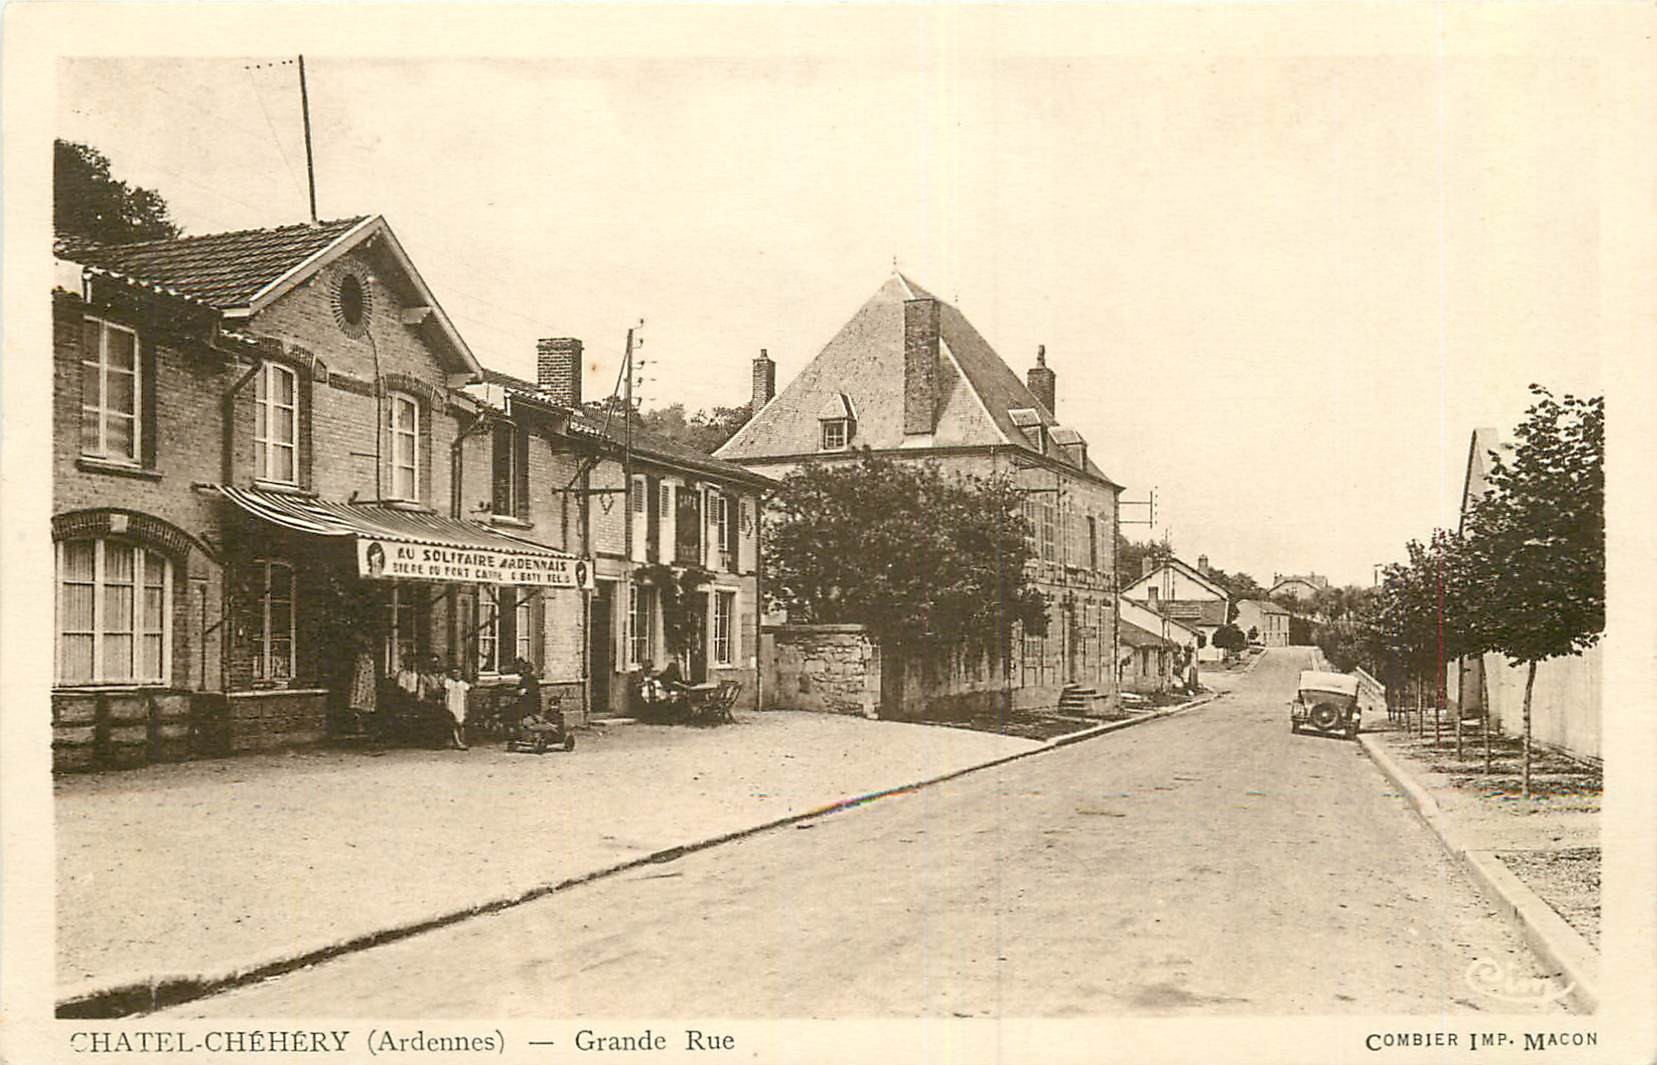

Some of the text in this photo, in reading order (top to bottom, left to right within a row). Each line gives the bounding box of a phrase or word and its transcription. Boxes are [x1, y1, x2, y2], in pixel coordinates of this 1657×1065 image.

[398, 547, 568, 573] AU SOLITAIRE ARDENNAIS
